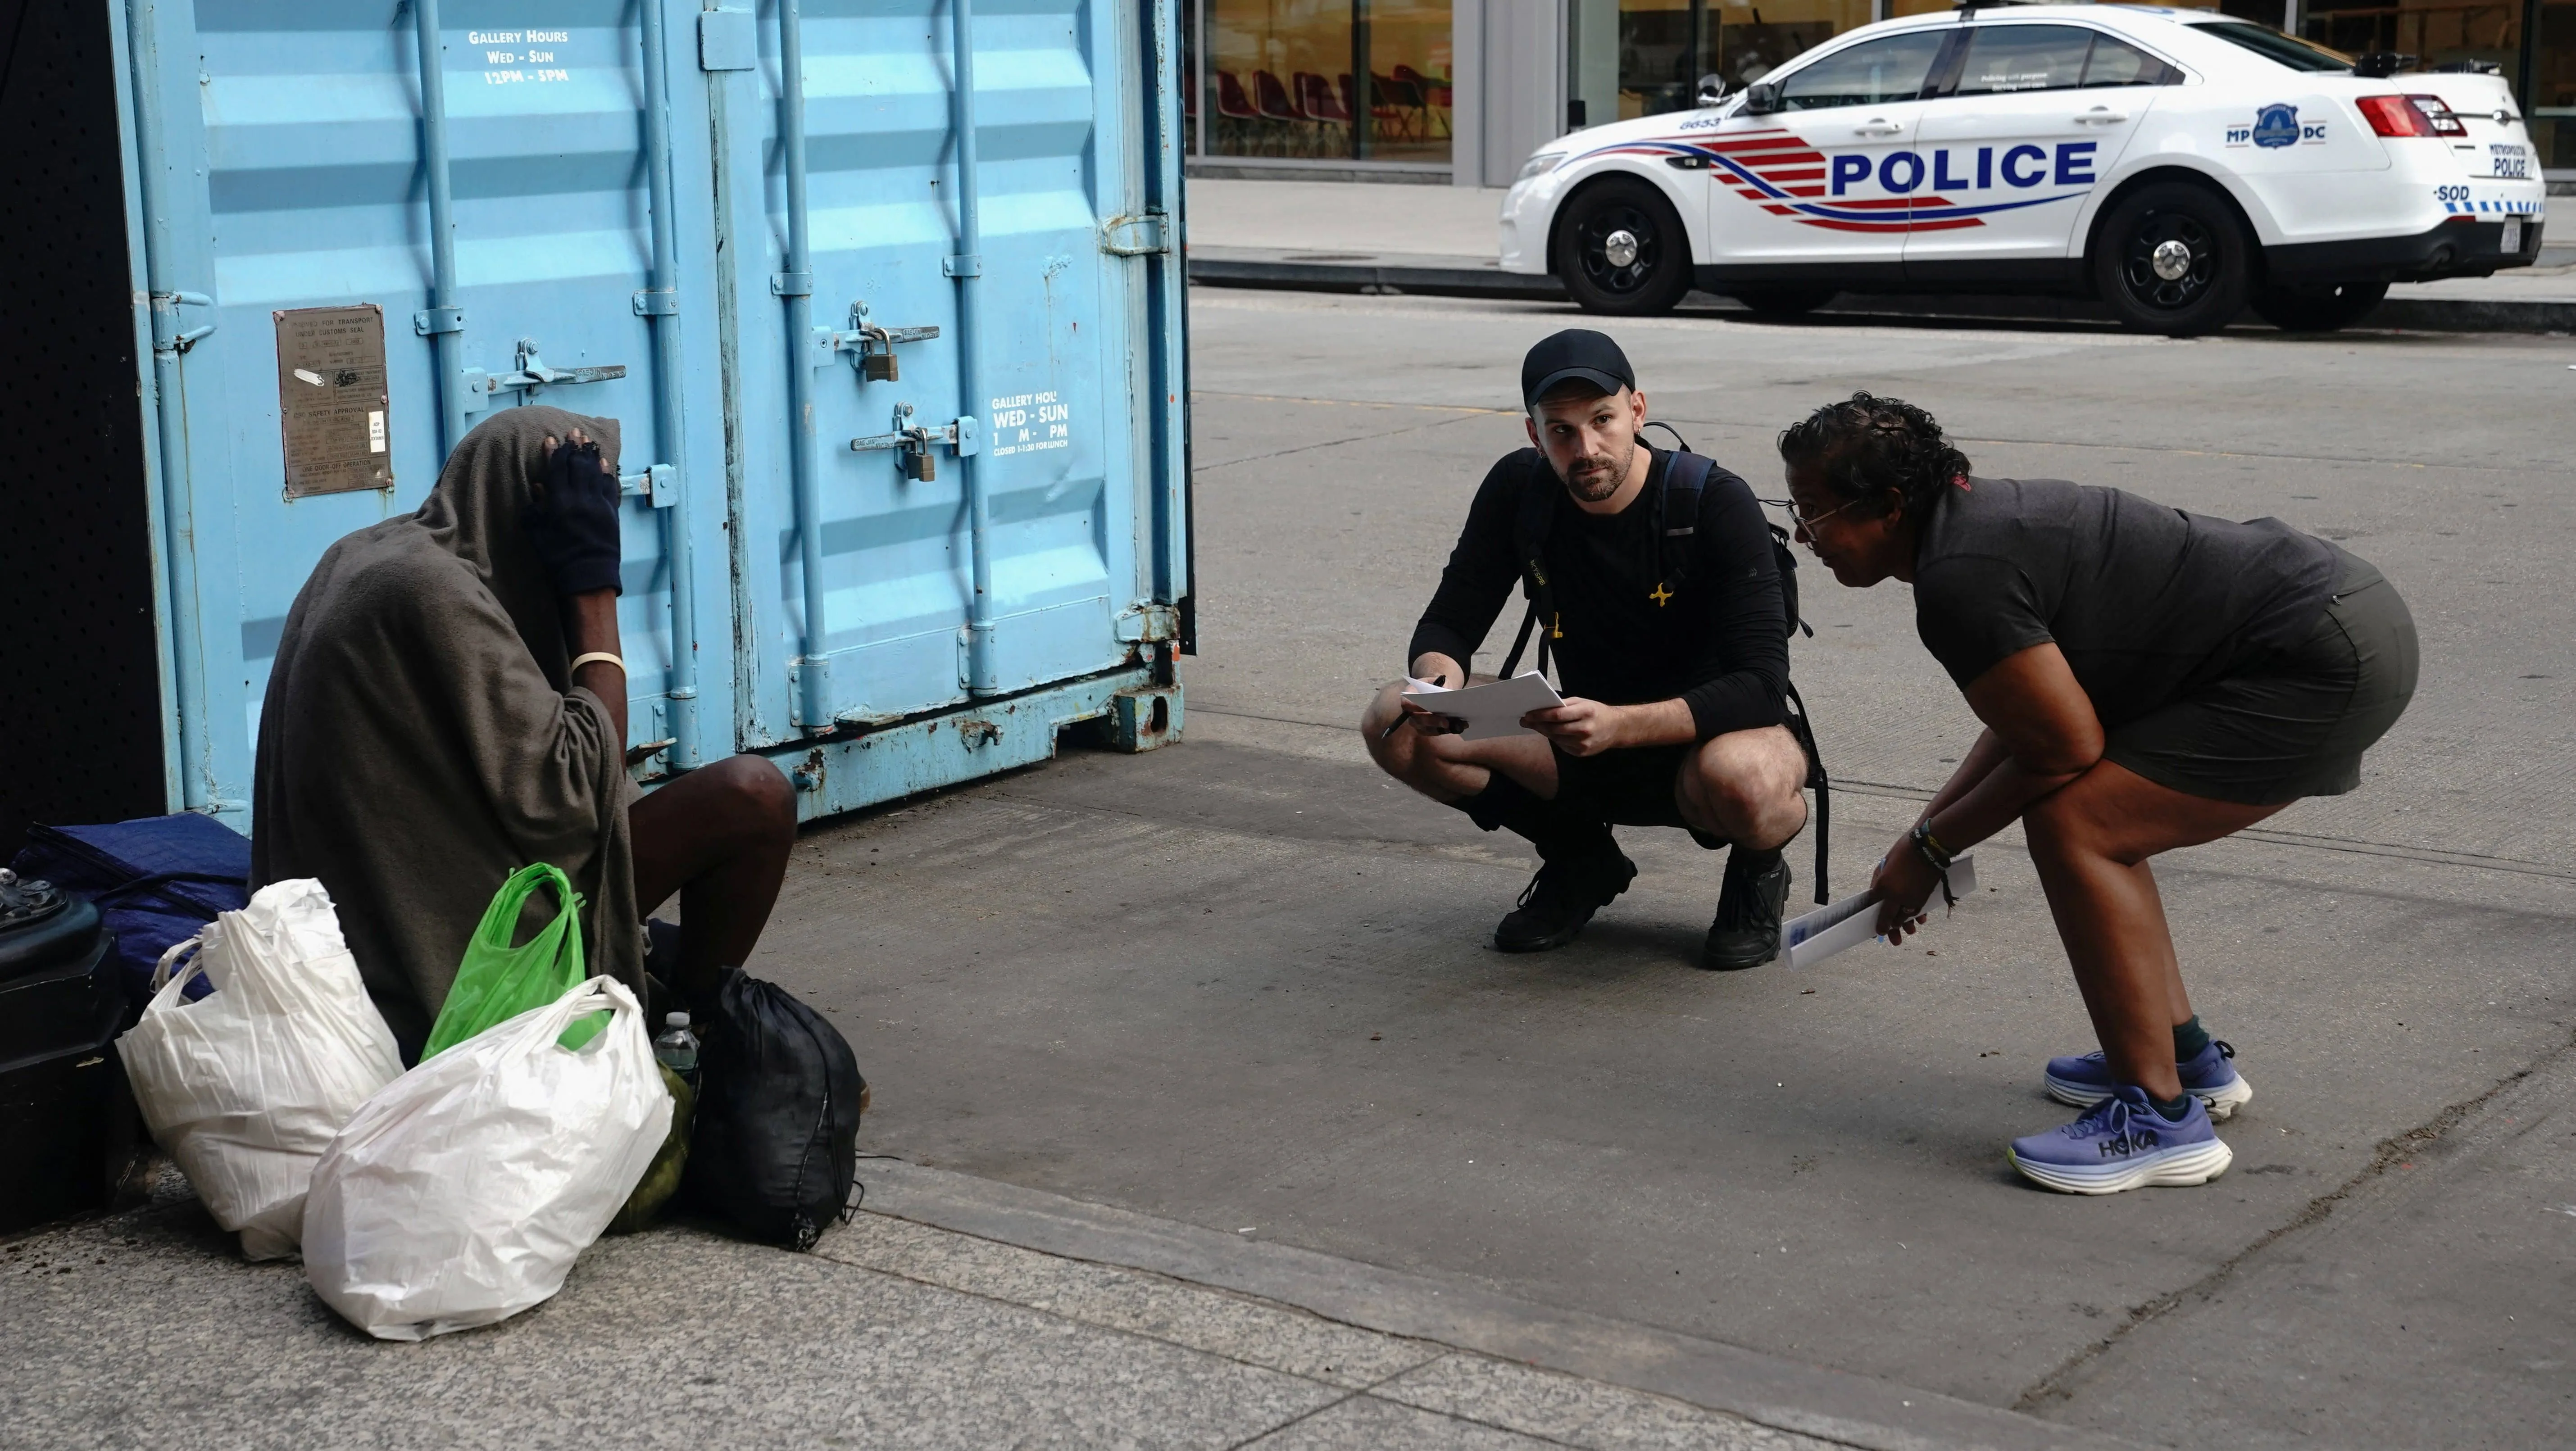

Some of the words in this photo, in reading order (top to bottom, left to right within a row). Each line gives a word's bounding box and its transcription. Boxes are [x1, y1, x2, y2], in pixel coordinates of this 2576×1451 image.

[485, 71, 524, 84] 12PM
[538, 69, 569, 82] 5PM
[2226, 130, 2250, 142] MP
[2304, 126, 2326, 139] DC
[1831, 142, 2097, 196] POLICE
[2494, 158, 2525, 177] POLICE
[2438, 185, 2469, 200] SOD
[319, 327, 346, 336] CUSTOMS
[992, 394, 1032, 410] GALLERY
[993, 409, 1026, 428] WED
[1039, 404, 1068, 423] SUN
[994, 446, 1015, 456] CLOSED
[1036, 442, 1047, 451] FOR
[1048, 440, 1068, 449] LUNCH
[315, 463, 341, 472] DOOR-OFF
[344, 459, 371, 468] OPERATION
[2098, 1129, 2158, 1157] HOKA
